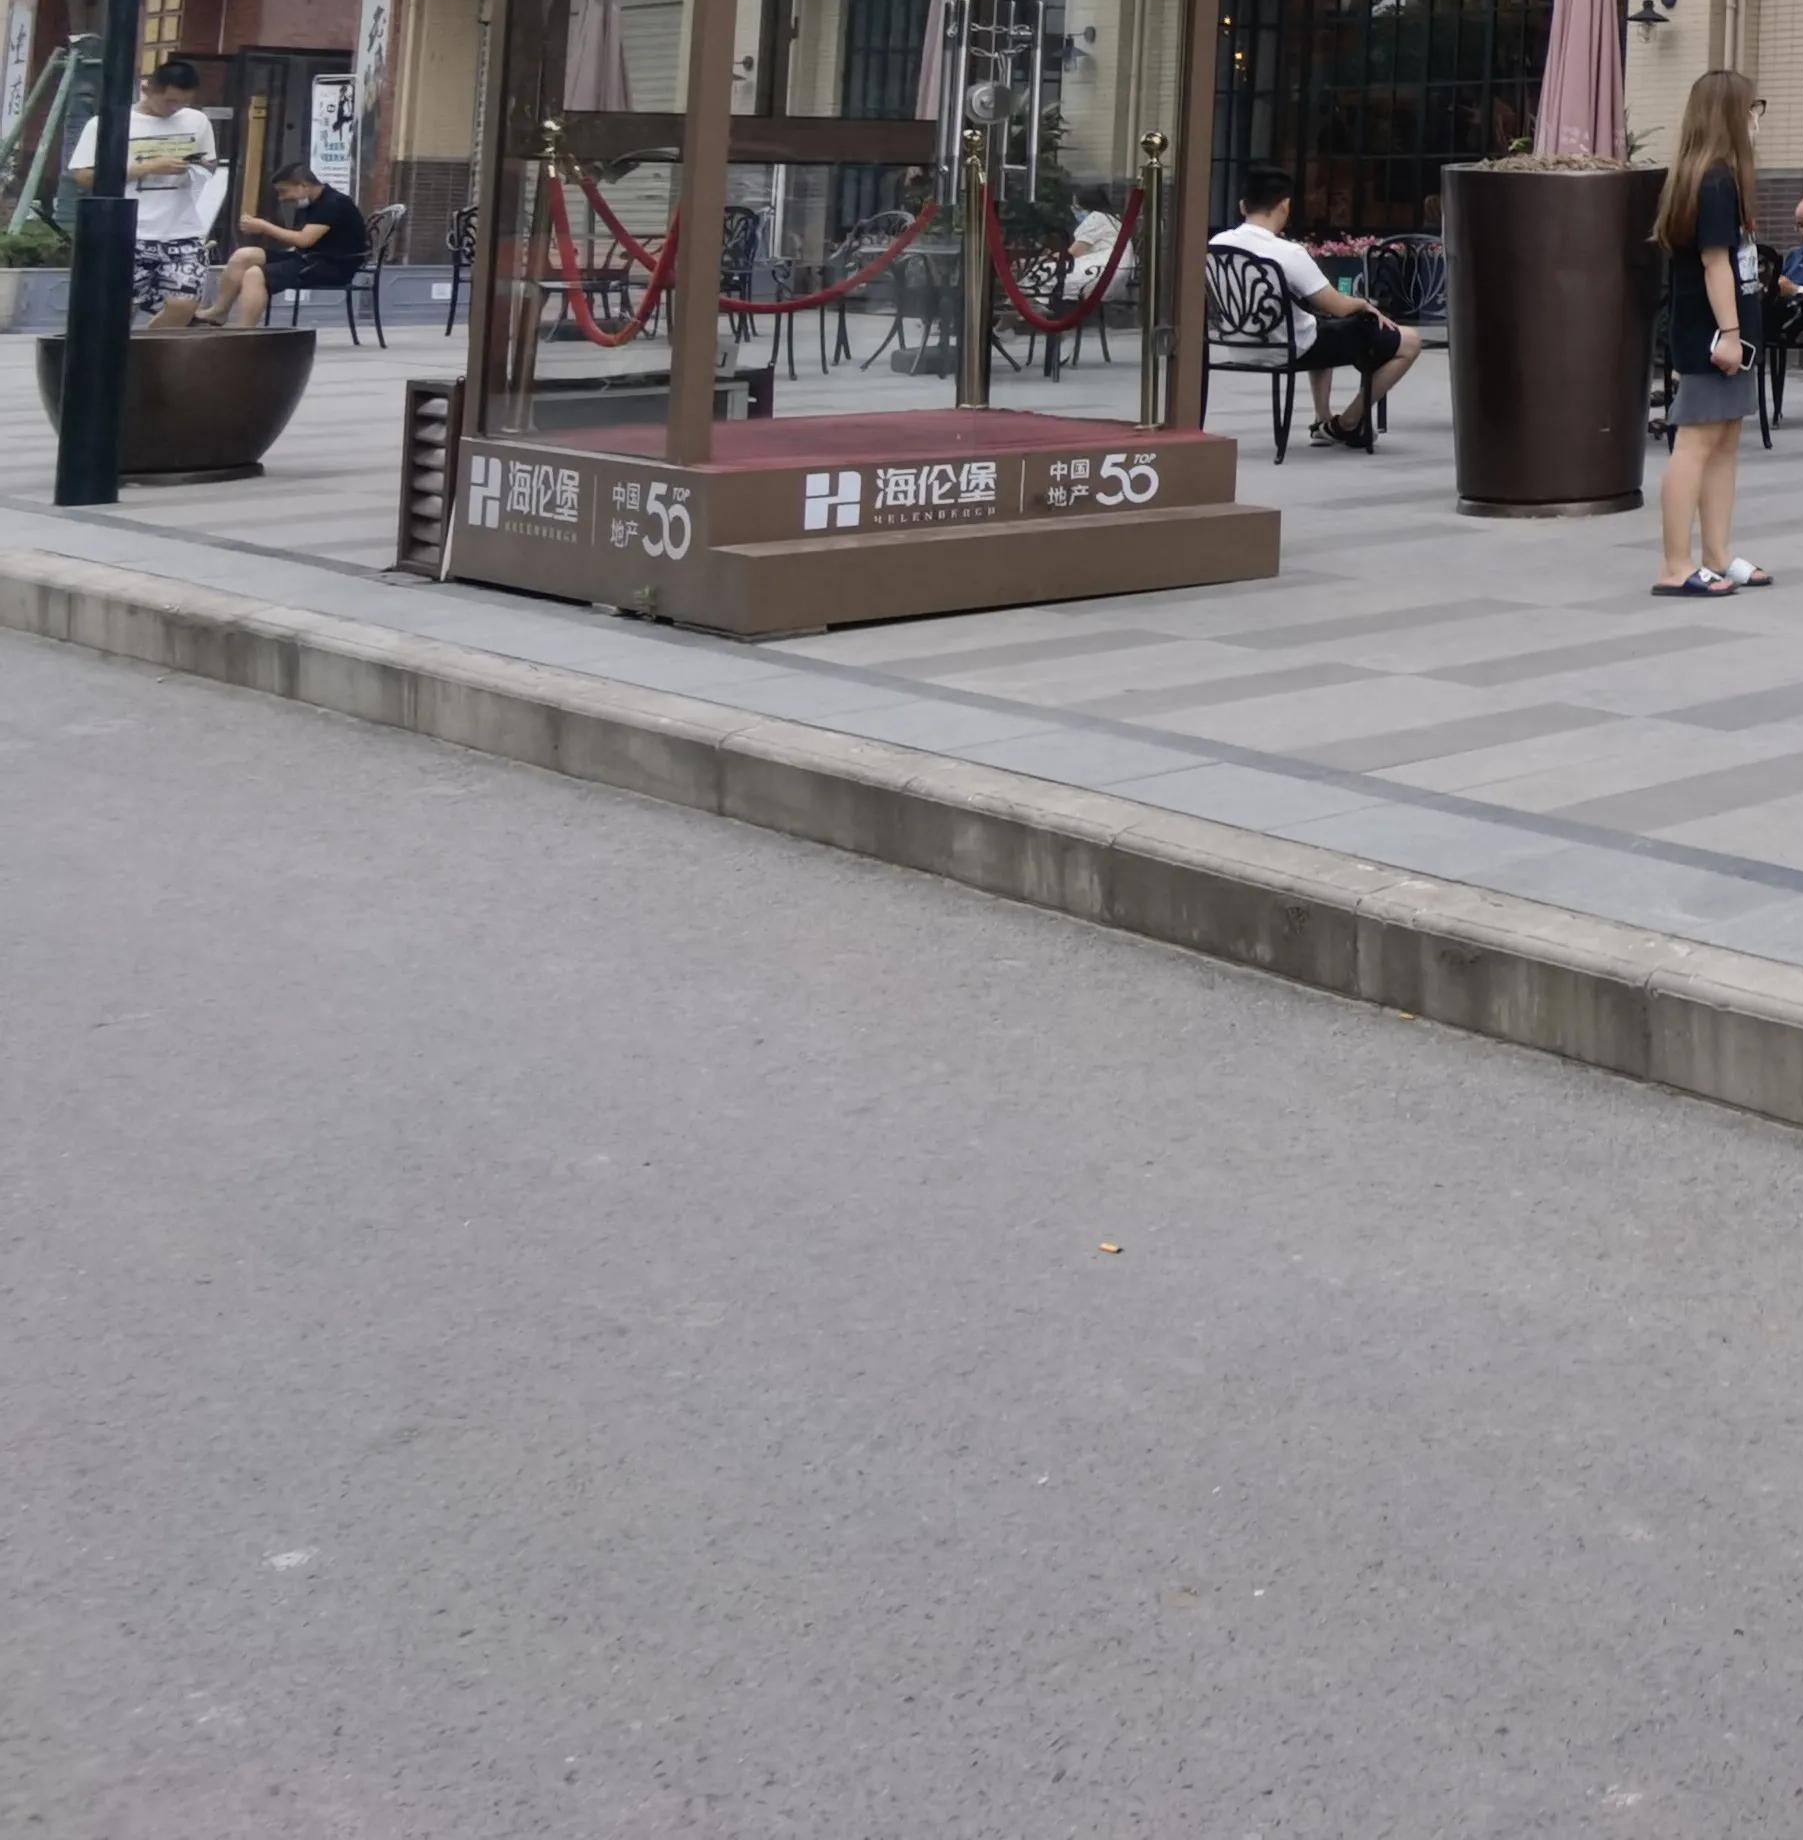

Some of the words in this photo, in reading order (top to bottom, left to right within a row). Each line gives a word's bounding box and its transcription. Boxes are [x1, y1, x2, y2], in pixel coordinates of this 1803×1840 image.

[874, 461, 997, 509] 海伦堡
[1133, 452, 1156, 464] TOP
[1050, 459, 1090, 482] 中国
[506, 460, 580, 523] 海伦堡
[673, 487, 691, 503] TOP
[612, 482, 641, 512] 中国
[1048, 485, 1090, 507] 地产
[610, 518, 640, 548] 地产
